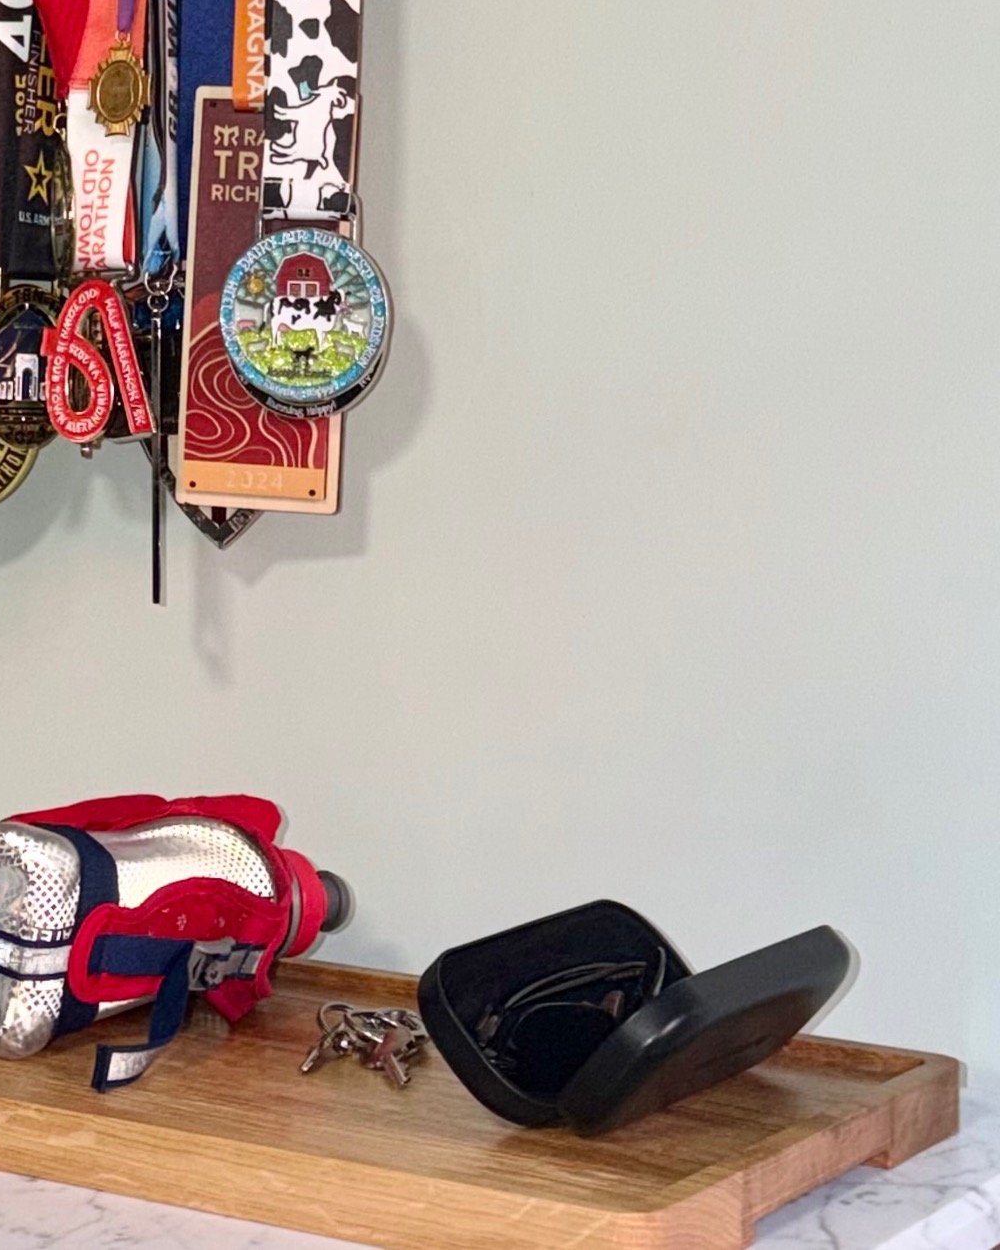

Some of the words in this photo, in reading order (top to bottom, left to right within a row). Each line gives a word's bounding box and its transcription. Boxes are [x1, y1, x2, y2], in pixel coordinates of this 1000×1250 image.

[24, 29, 42, 135] FINISHER
[82, 149, 100, 196] OLD
[213, 150, 259, 180] TR
[210, 184, 258, 203] RICH
[91, 157, 116, 271] ARATHON
[77, 199, 94, 271] TOWN
[241, 236, 278, 273] DAIRY
[280, 229, 309, 247] AIR
[312, 229, 342, 250] RUN
[78, 287, 99, 307] OLD
[103, 297, 122, 330] HALF
[59, 301, 80, 340] TOWN
[50, 385, 68, 426] TOWN
[226, 469, 284, 490] 2024
